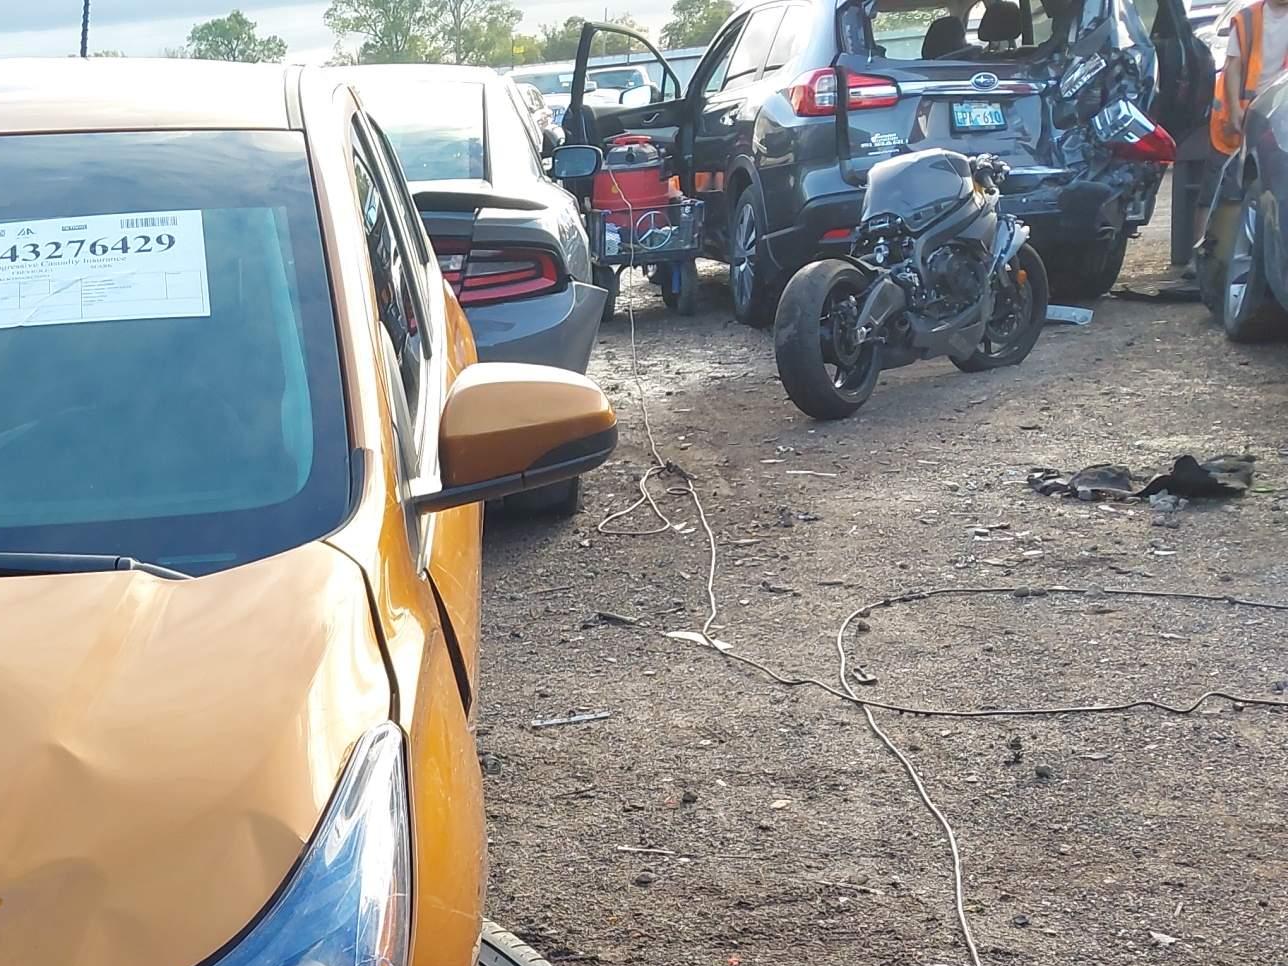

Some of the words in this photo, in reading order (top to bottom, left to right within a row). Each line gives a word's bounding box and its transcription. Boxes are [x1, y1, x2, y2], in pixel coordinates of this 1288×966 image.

[0, 233, 176, 263] 43276429
[40, 258, 80, 268] Casualty
[83, 256, 127, 264] Insurance
